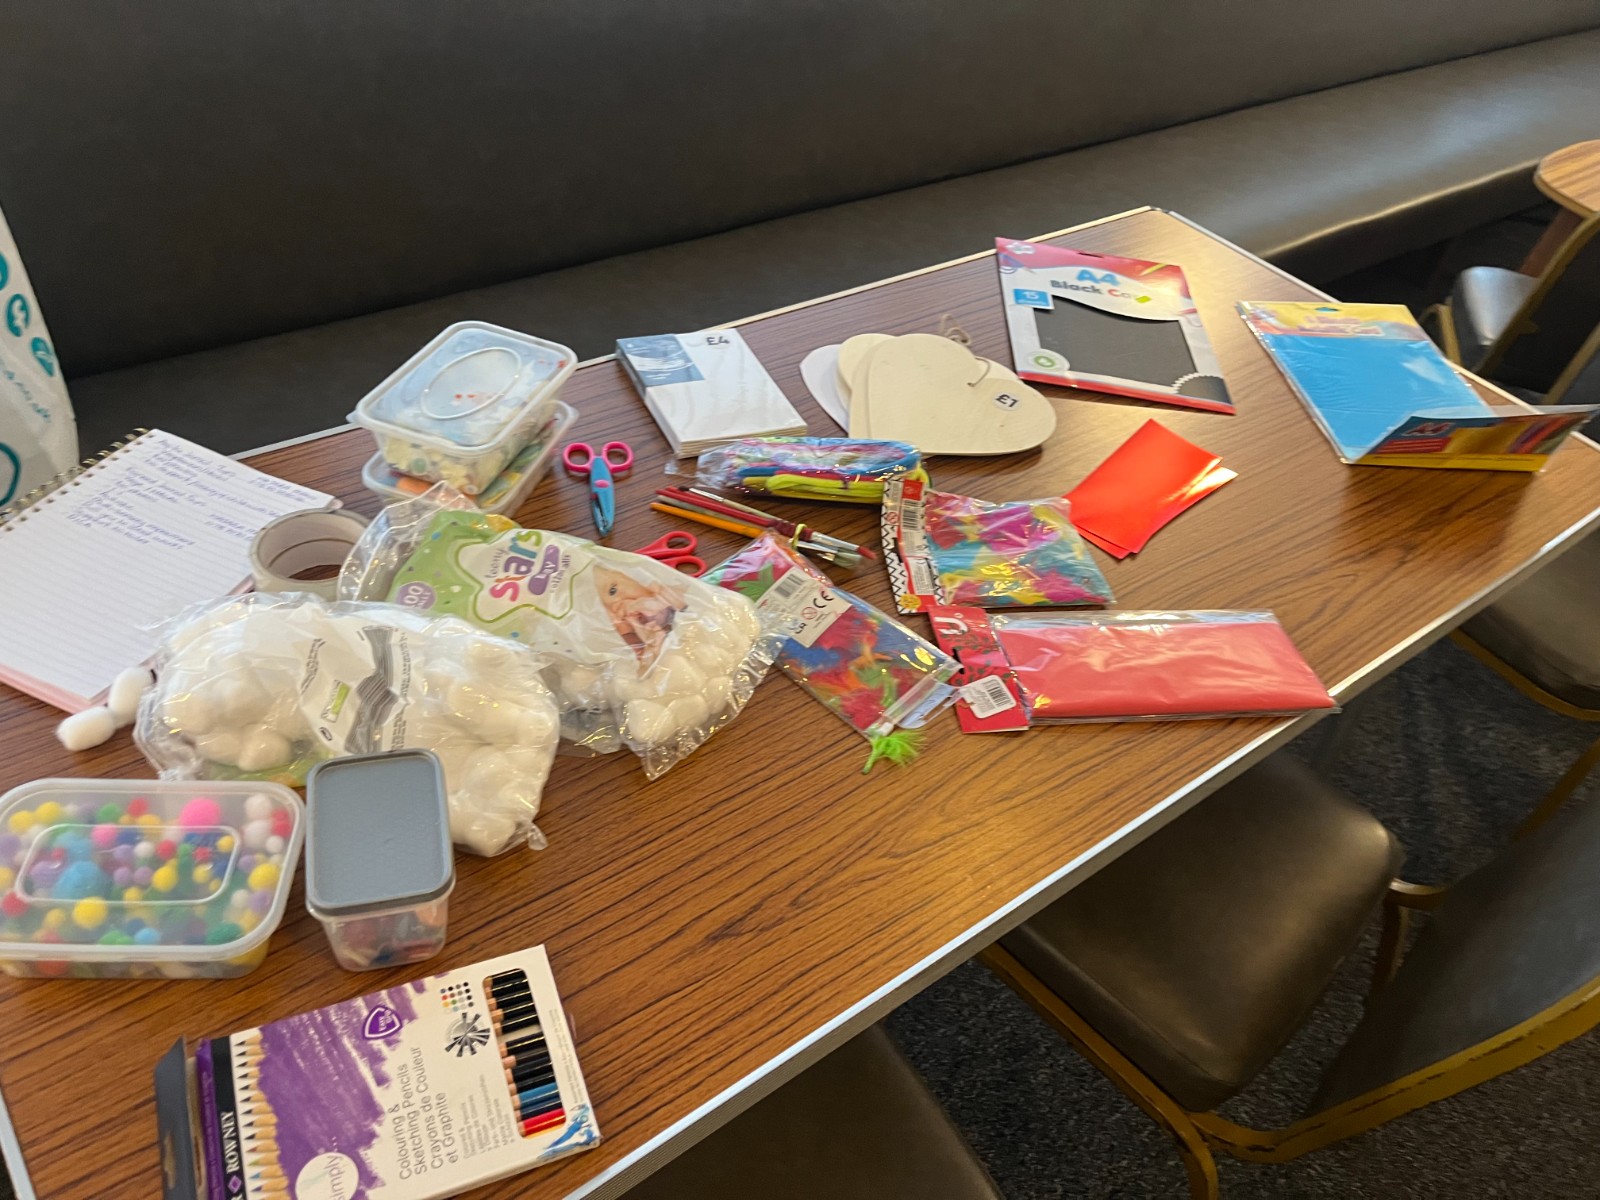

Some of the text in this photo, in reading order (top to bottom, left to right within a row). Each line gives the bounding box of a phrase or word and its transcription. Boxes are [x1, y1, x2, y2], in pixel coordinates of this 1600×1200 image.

[1050, 279, 1105, 295] Black
[1076, 269, 1120, 287] A4
[706, 335, 730, 346] £4
[489, 530, 542, 602] stars
[220, 1110, 240, 1174] ROWNEY
[388, 1103, 413, 1180] Colouring &
[397, 1063, 428, 1175] Sketching Pencils
[411, 1047, 444, 1169] Crayons de Couleur
[435, 1092, 459, 1164] et Graphite
